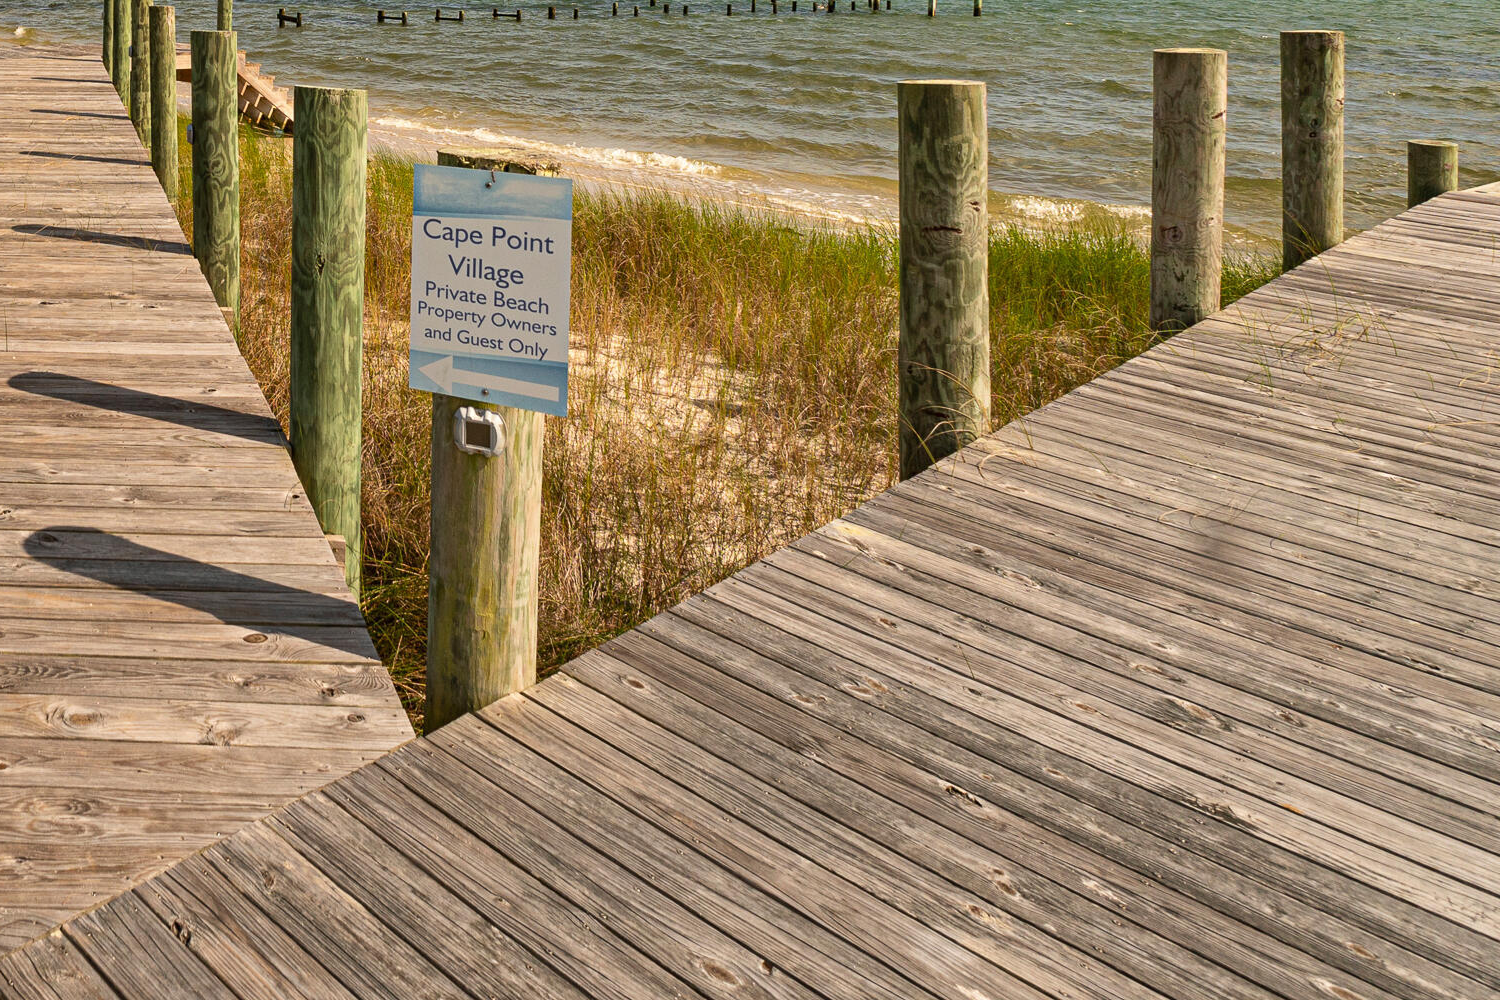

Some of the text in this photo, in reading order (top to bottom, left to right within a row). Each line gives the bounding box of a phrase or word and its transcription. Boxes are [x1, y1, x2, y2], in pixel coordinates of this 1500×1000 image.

[423, 218, 554, 254] Cape Point
[448, 254, 524, 288] Village
[425, 280, 549, 314] Private Beach
[418, 301, 557, 336] Property Owners
[424, 326, 548, 361] and Guest Only
